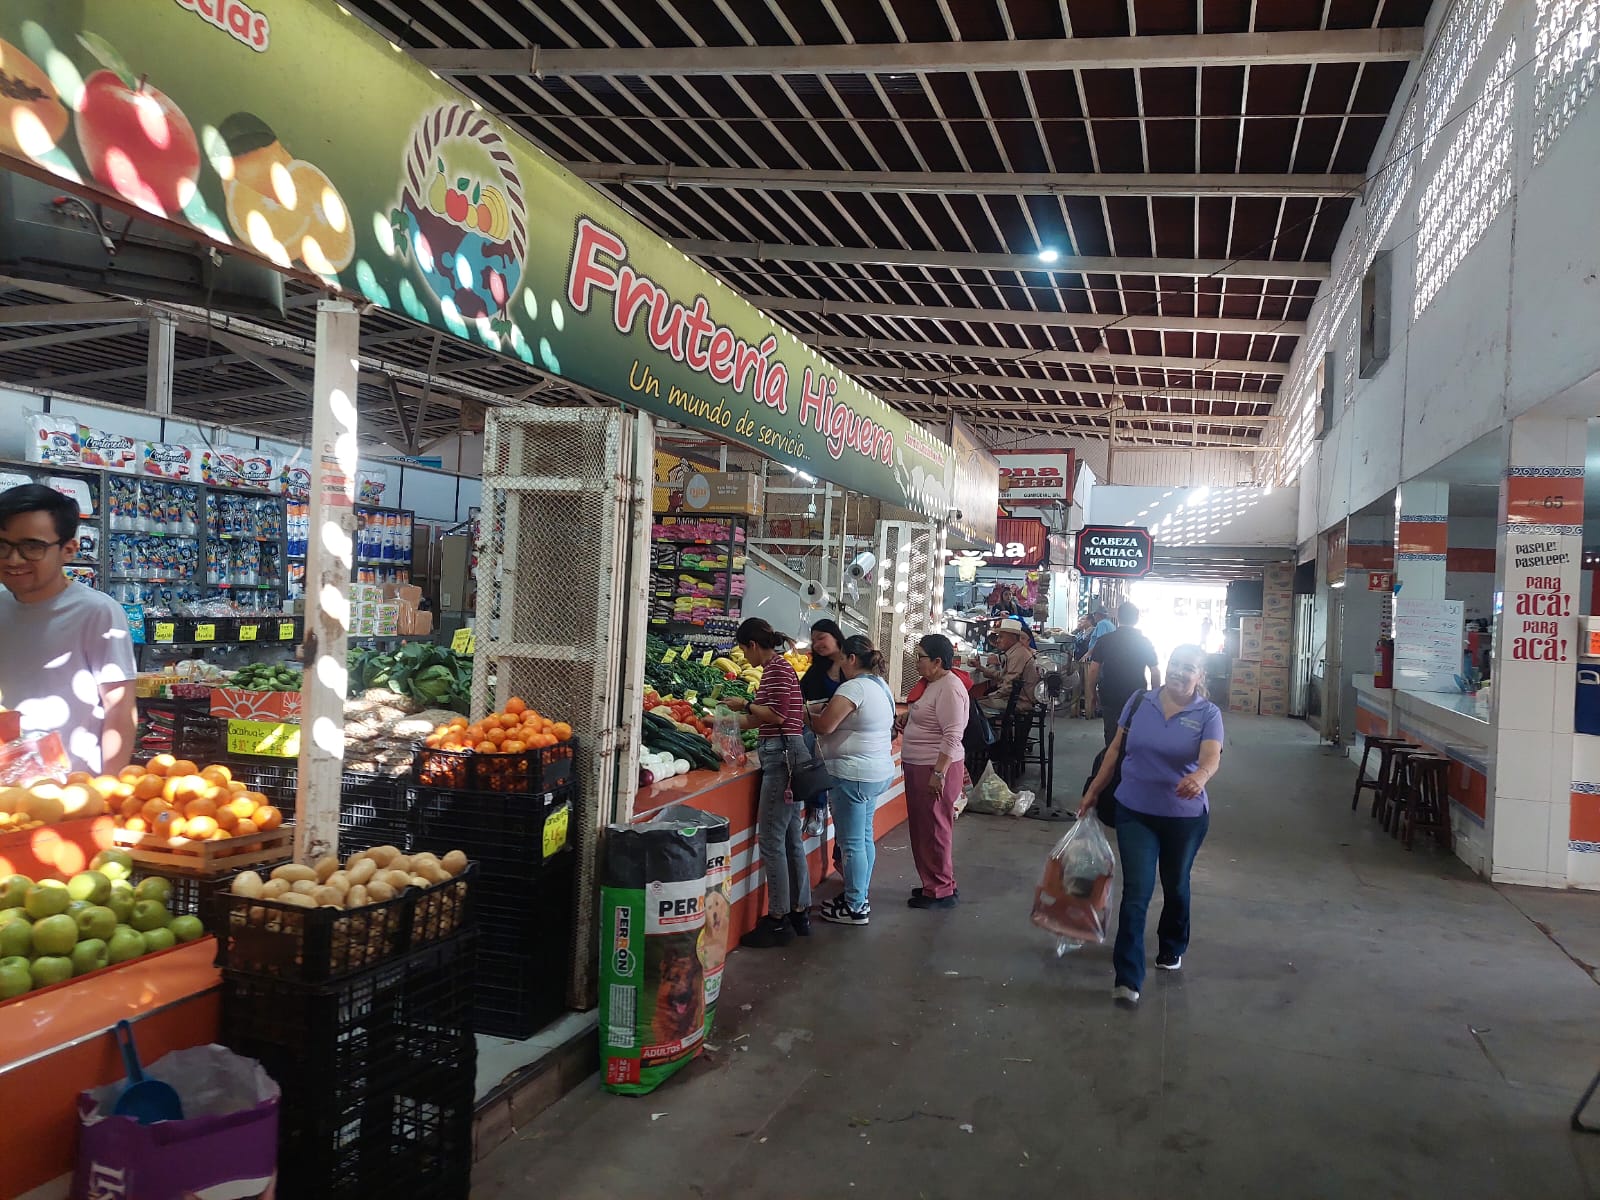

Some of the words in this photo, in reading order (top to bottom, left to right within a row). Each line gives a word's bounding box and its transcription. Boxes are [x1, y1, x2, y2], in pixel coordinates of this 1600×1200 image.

[568, 218, 789, 415] Frutería
[799, 368, 895, 467] Higuera
[629, 360, 660, 398] Un
[668, 385, 731, 428] mundo
[736, 408, 754, 438] de
[1544, 495, 1563, 509] 65
[1090, 536, 1138, 547] CABEZA
[1084, 546, 1143, 558] MACHACA
[1089, 557, 1138, 568] MENUDO
[644, 1045, 681, 1058] ADULTOS
